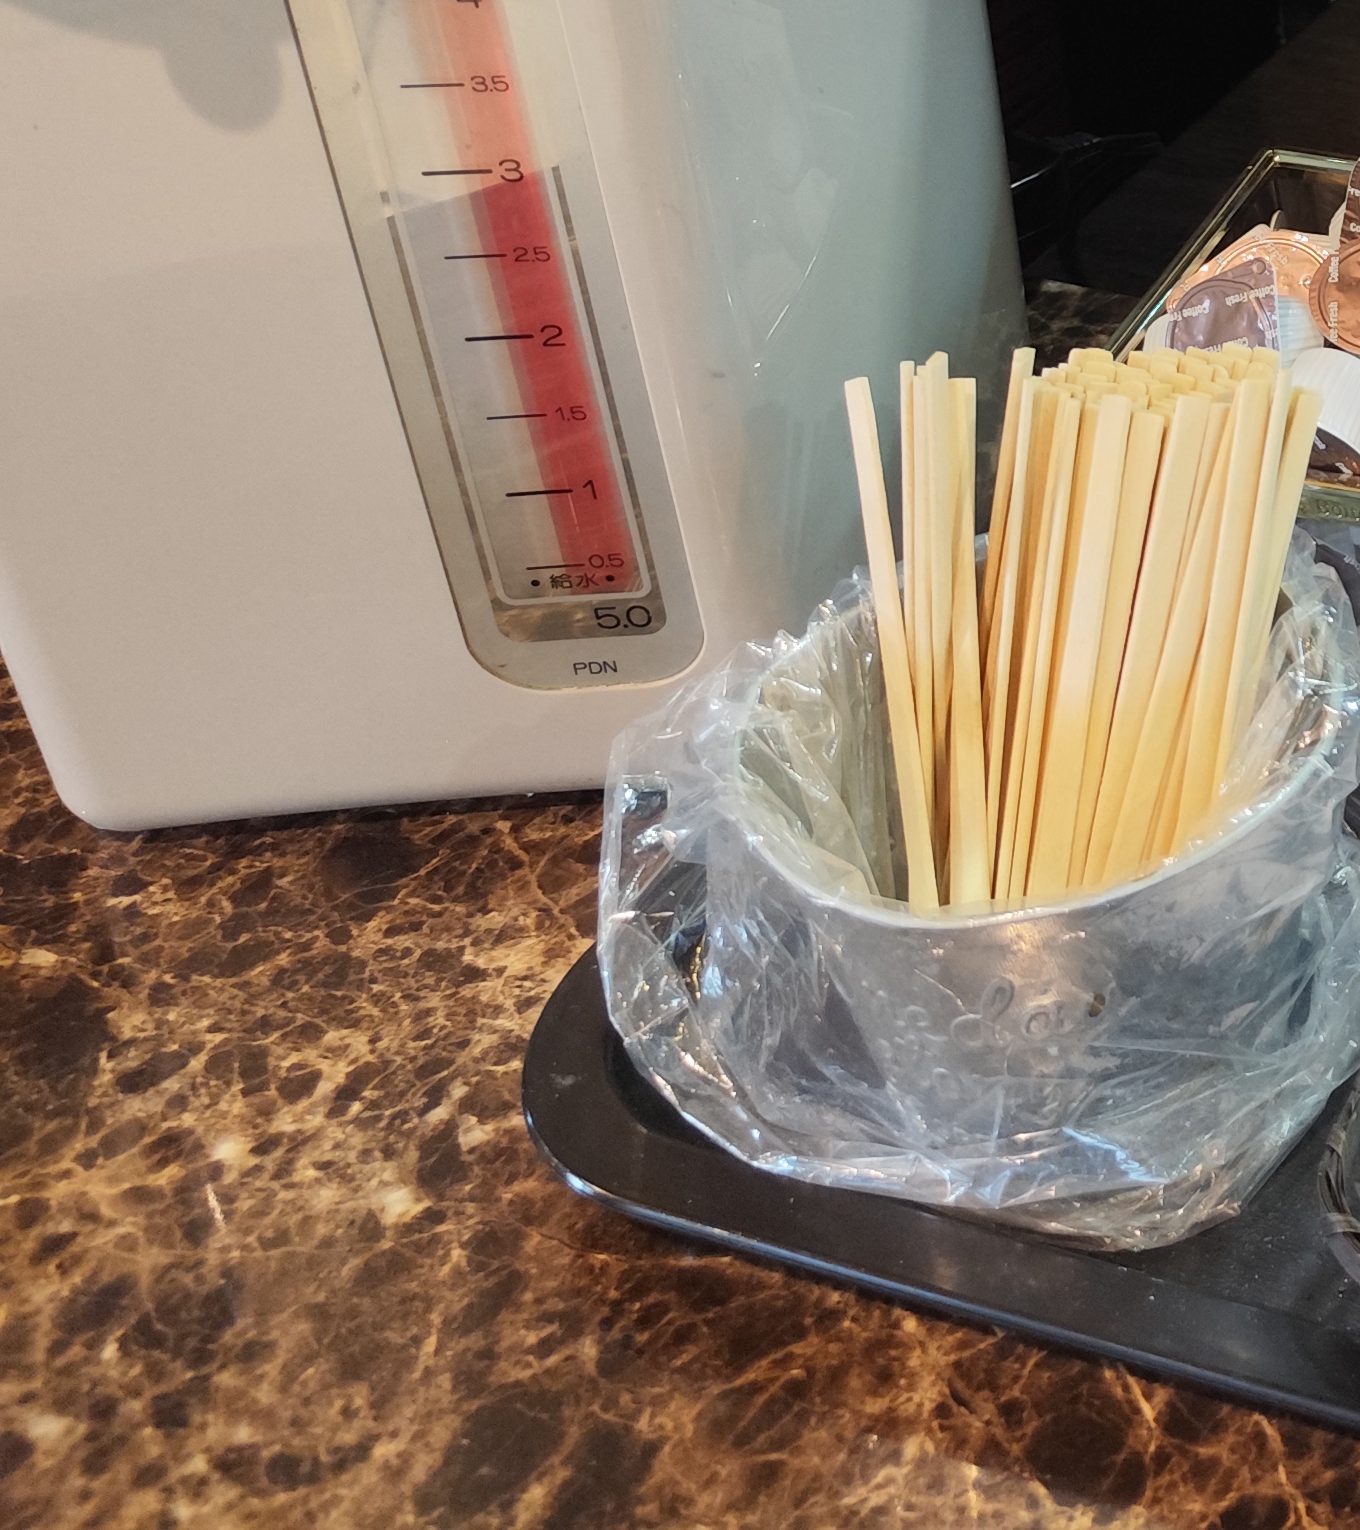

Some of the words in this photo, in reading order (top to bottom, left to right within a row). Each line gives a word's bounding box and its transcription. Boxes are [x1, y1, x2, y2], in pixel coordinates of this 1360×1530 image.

[470, 75, 510, 93] 3.5
[498, 159, 524, 183] 3
[512, 246, 552, 263] 2.5
[1328, 301, 1339, 327] Fresh
[539, 324, 567, 348] 2
[554, 405, 588, 422] 1.5
[582, 479, 599, 501] 1
[588, 552, 625, 570] 0.5
[549, 573, 600, 591] 給水
[594, 605, 653, 630] 5.0
[572, 660, 618, 676] PDN
